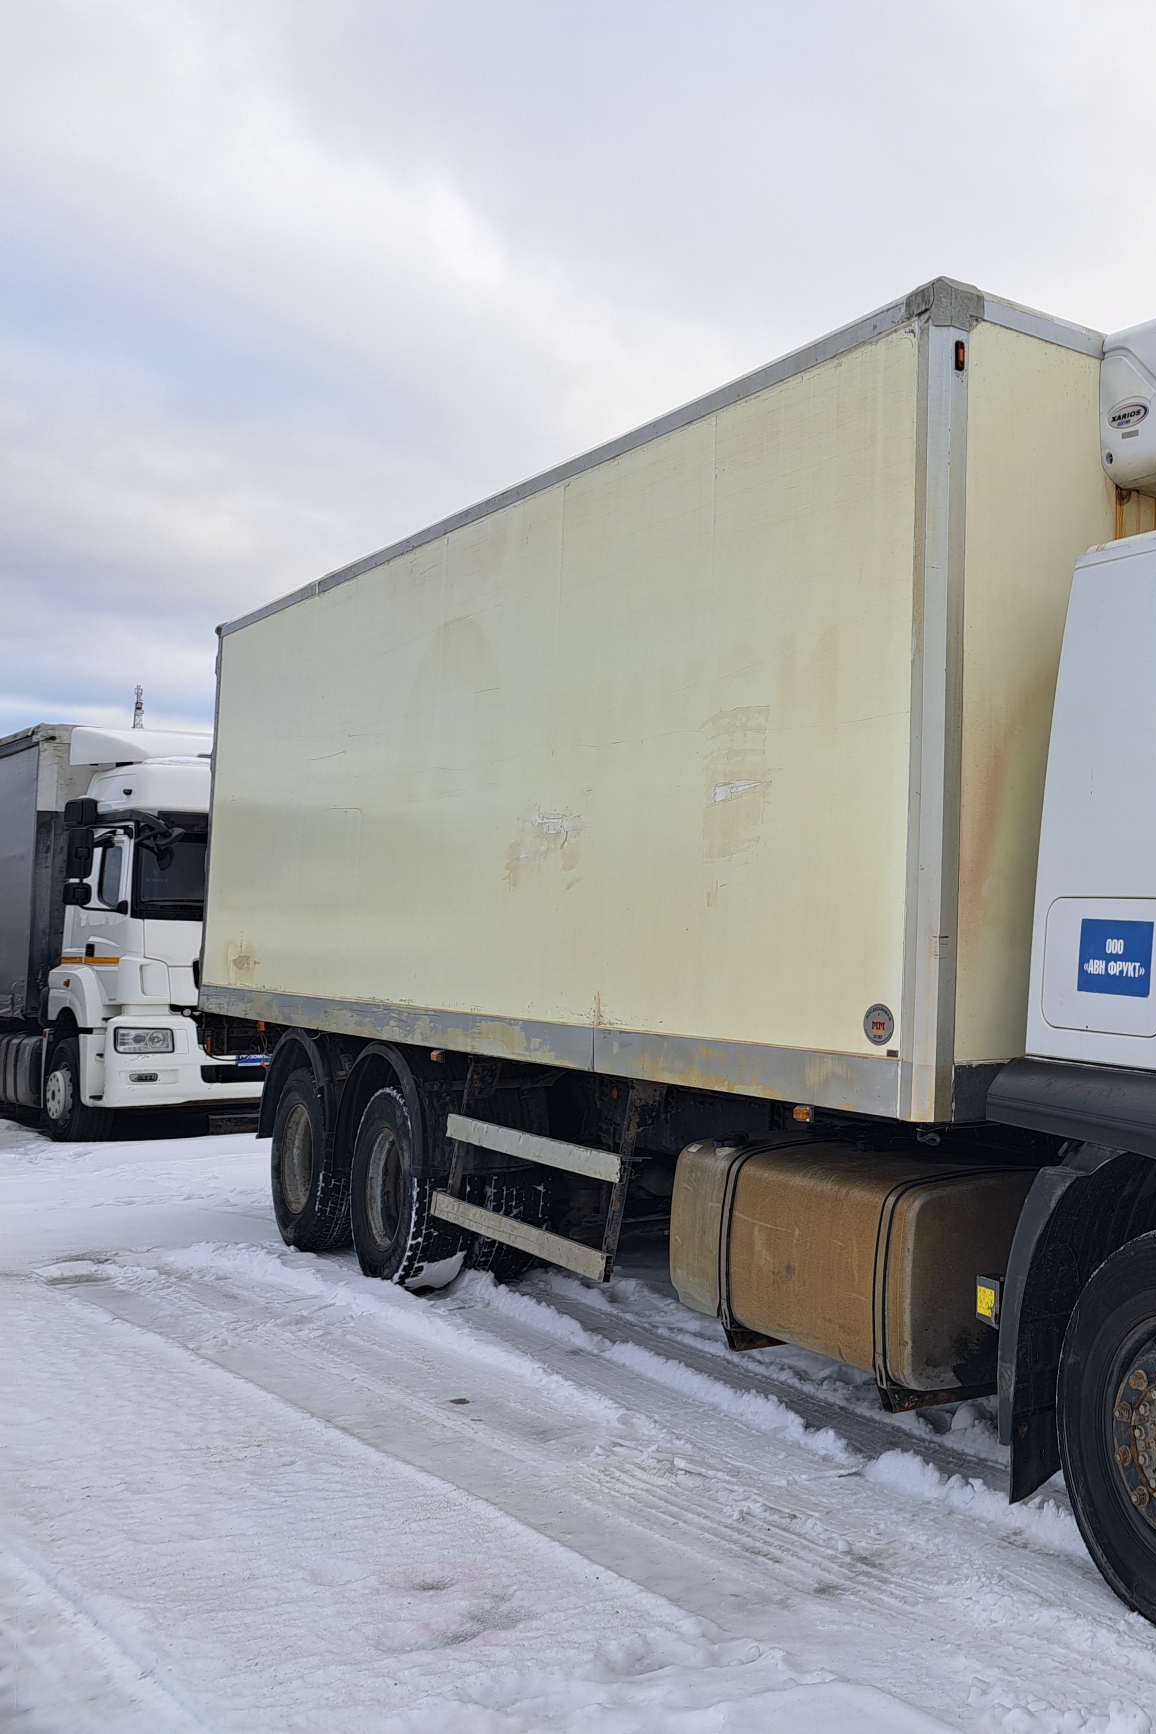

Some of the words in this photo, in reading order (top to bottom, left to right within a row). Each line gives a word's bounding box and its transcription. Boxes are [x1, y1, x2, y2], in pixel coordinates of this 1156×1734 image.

[1110, 409, 1142, 422] XARIOS
[1105, 938, 1124, 954] ООО
[1084, 959, 1106, 975] «АВН
[1107, 960, 1145, 978] ФРУКТ»
